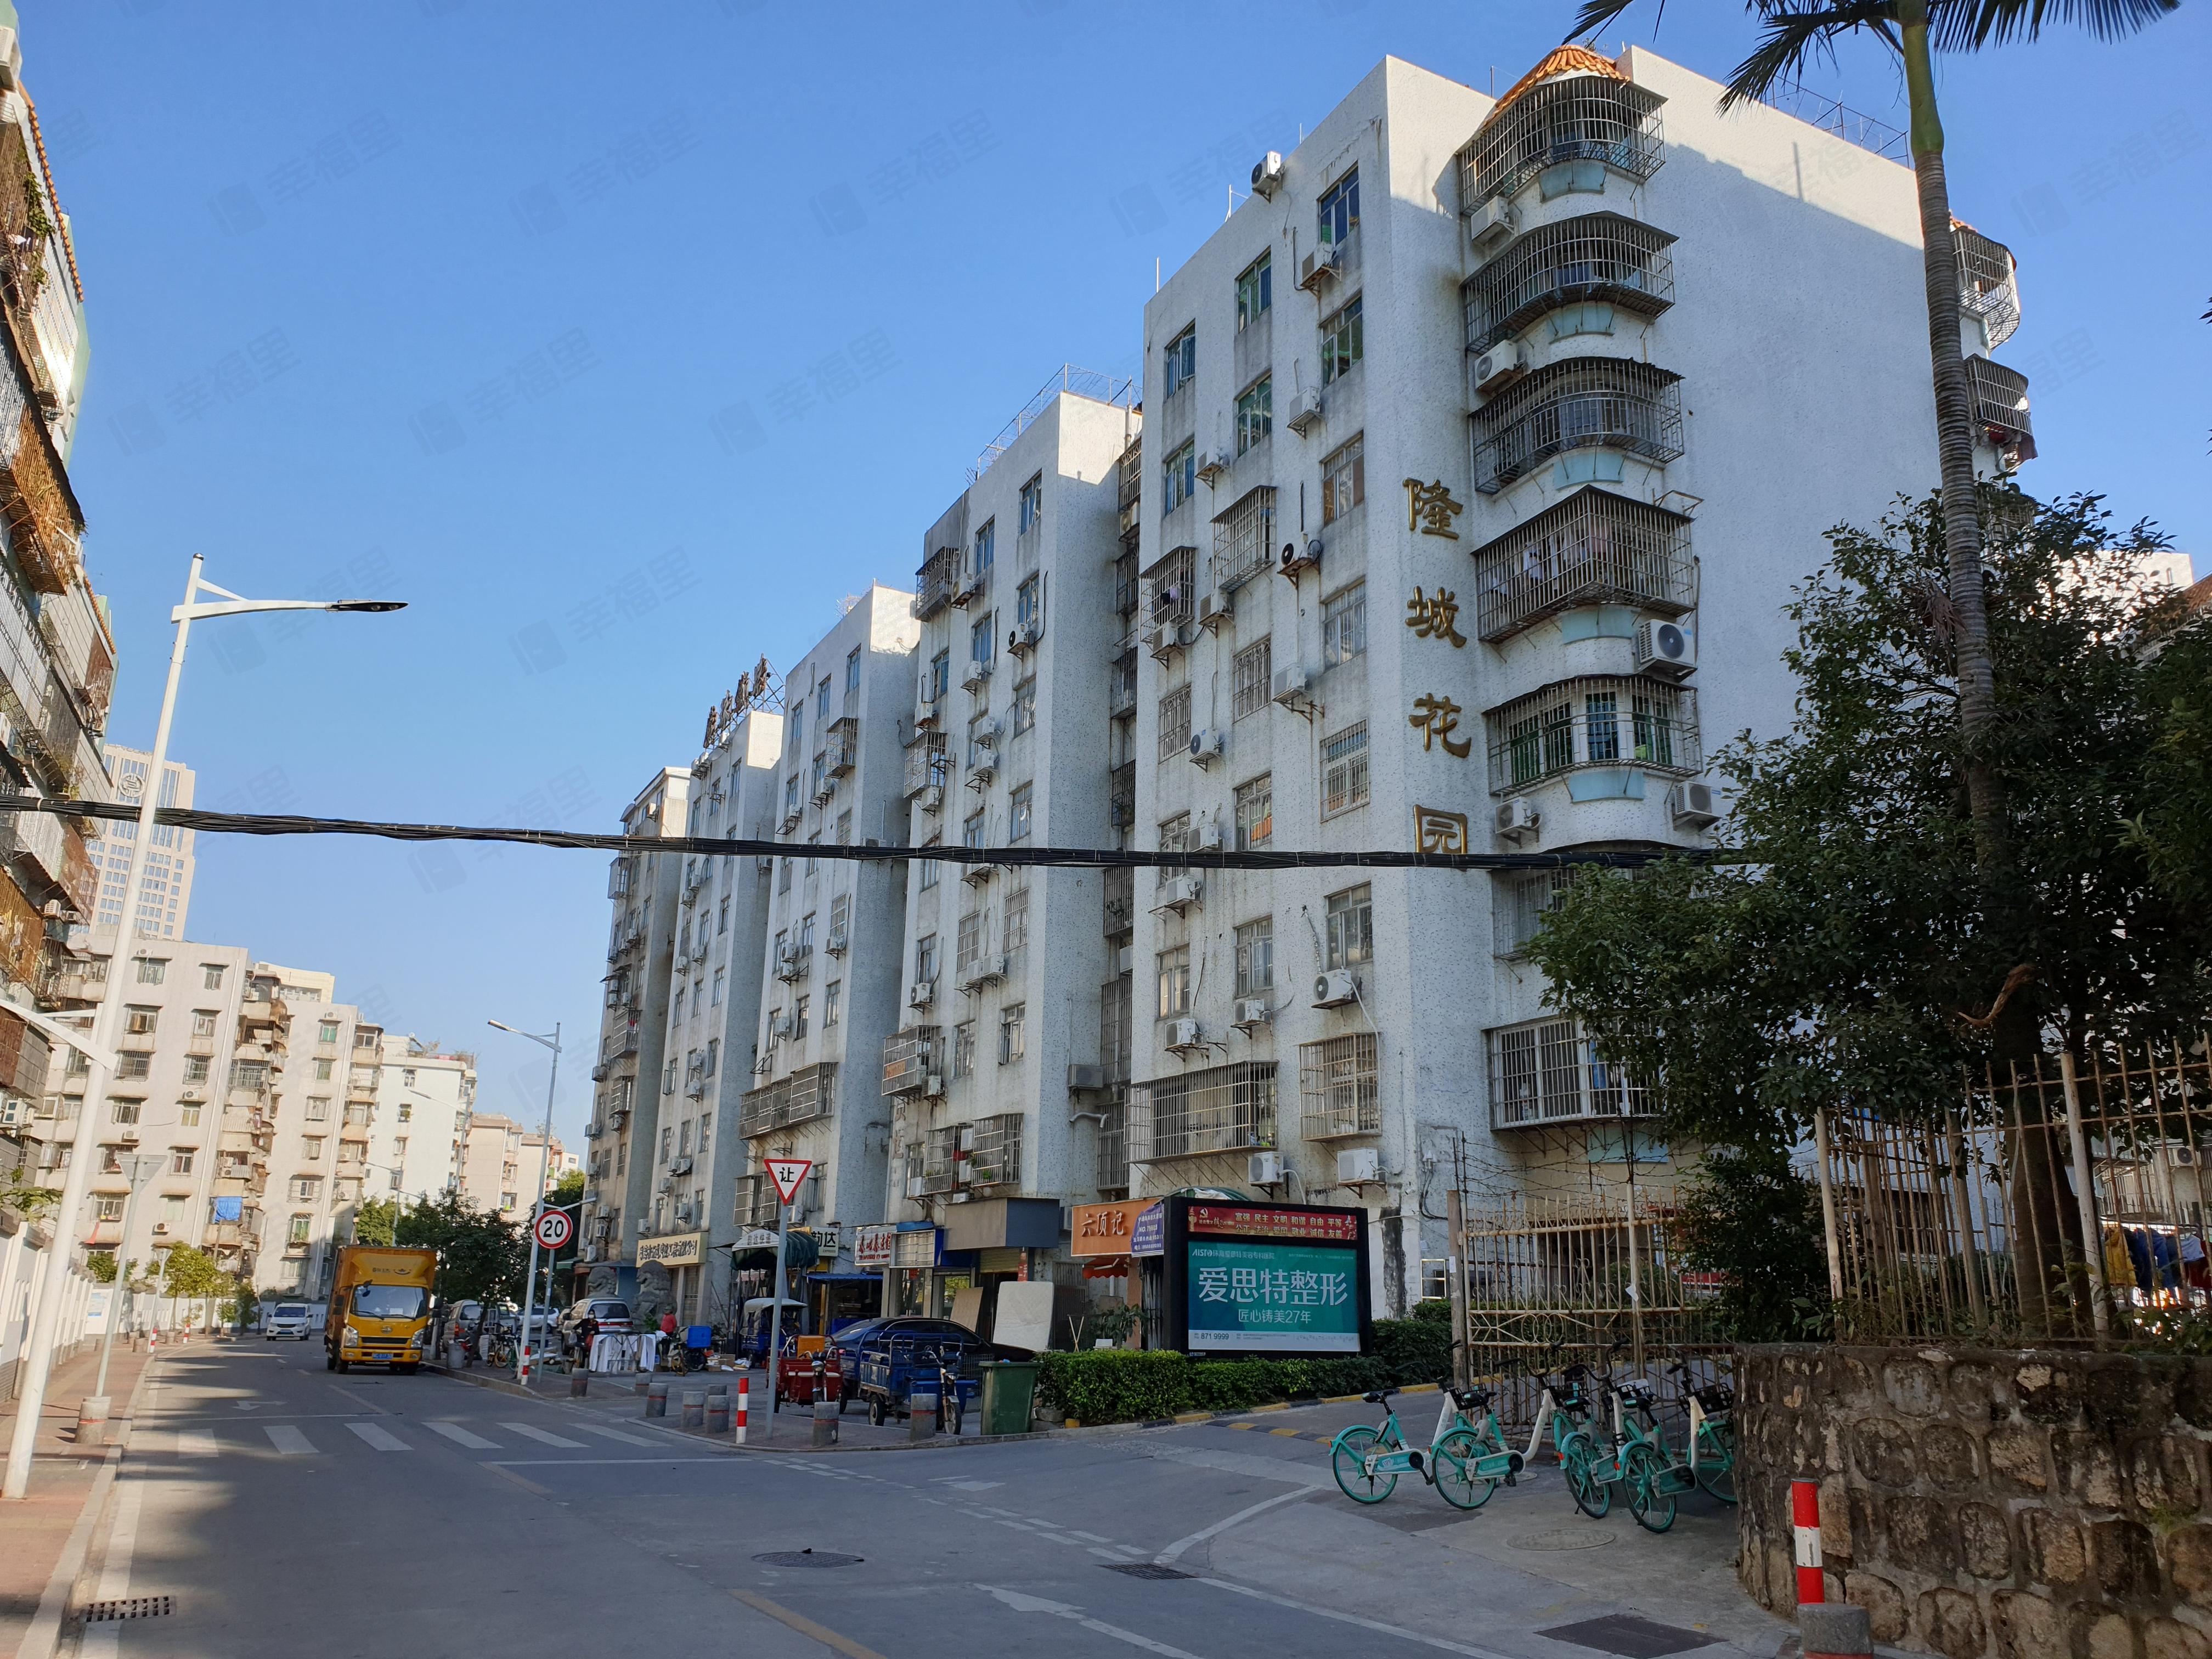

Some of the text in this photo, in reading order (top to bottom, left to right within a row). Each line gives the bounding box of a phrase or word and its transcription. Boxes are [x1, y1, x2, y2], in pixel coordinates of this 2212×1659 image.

[1402, 477, 1471, 871] 隆城花园
[780, 1167, 794, 1182] 让
[1235, 1212, 1342, 1227] 富强 民主 文明 和谐 自由 平等
[544, 1220, 563, 1238] 20
[1235, 1224, 1342, 1238] 公正 法治 爱国 敬业 诚信 友善
[1199, 1267, 1347, 1306] 爱思特整形
[1238, 1310, 1312, 1324] 匠心铸美27年
